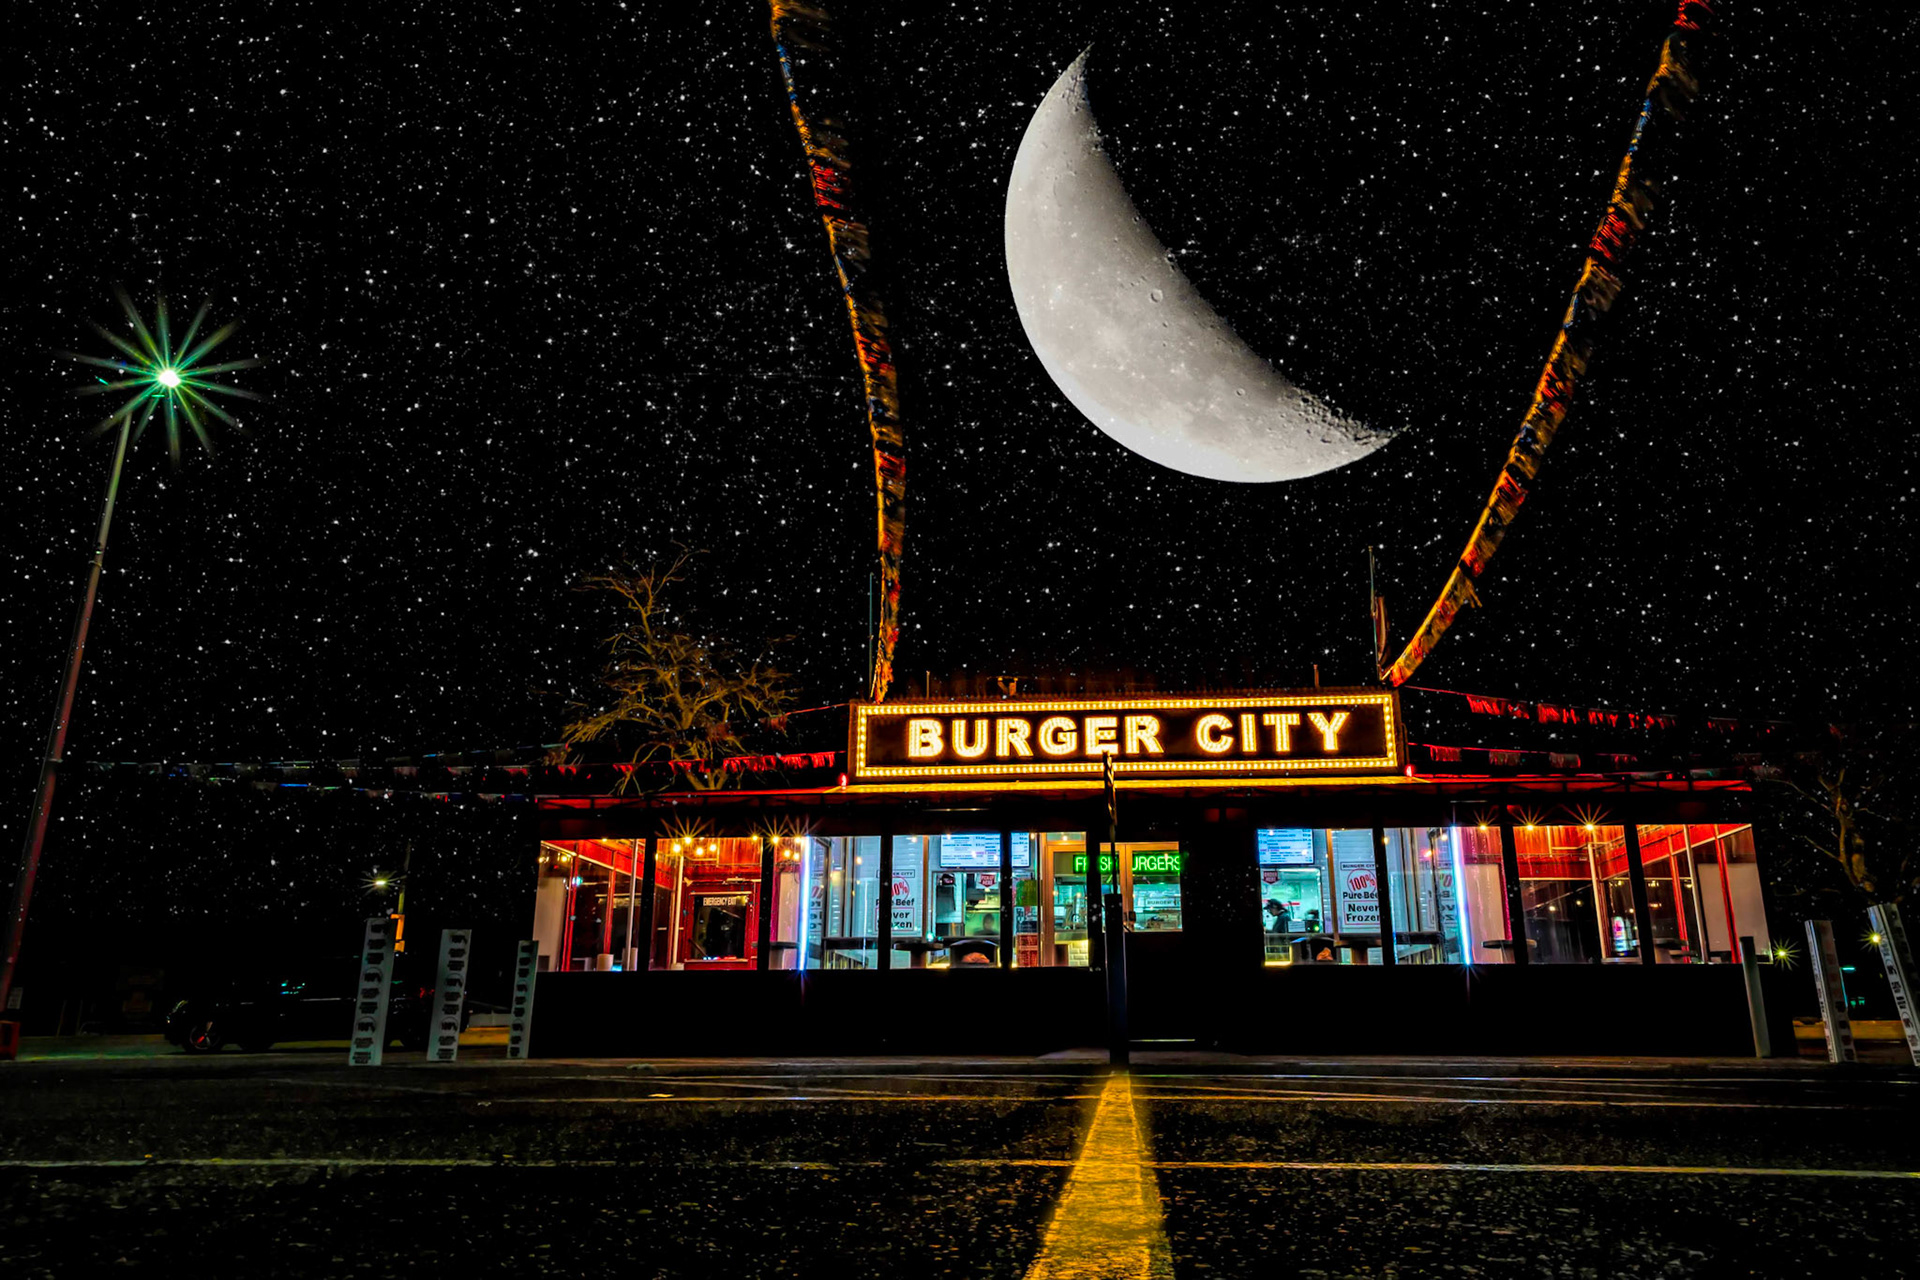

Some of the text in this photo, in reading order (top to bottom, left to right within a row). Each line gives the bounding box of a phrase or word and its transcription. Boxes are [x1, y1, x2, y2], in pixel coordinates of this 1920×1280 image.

[908, 711, 1350, 758] BURGER CITY
[1349, 873, 1377, 891] 100%
[1342, 891, 1363, 899] Pure
[895, 898, 915, 906] Beef
